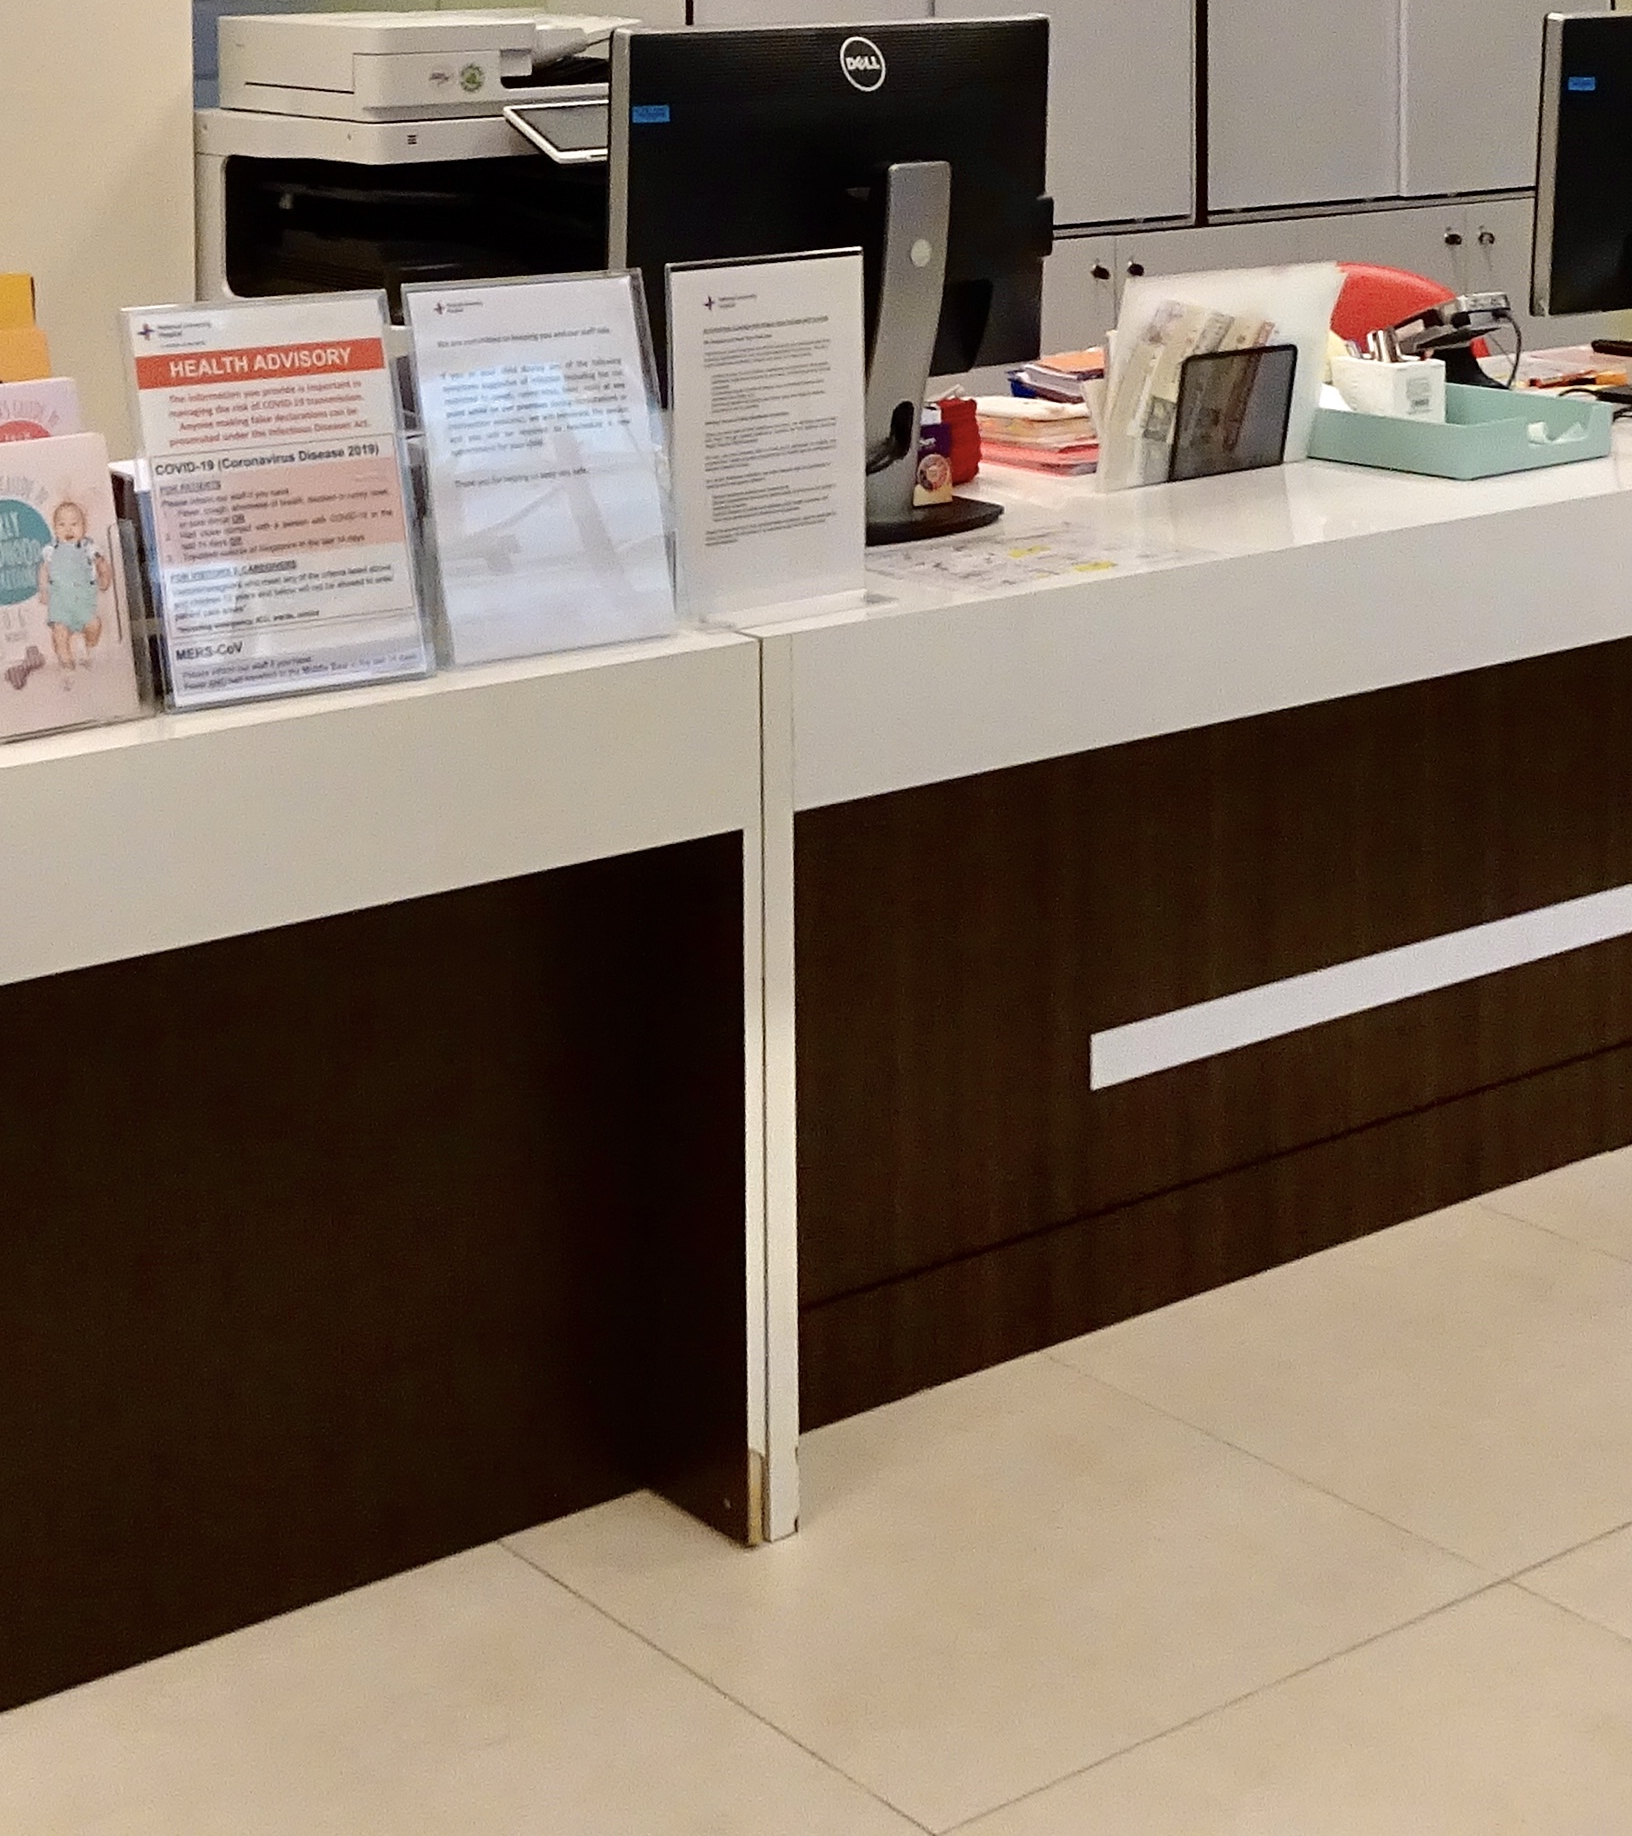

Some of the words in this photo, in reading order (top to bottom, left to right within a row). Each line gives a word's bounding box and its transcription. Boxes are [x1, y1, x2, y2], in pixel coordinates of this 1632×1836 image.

[169, 355, 248, 379] HEALTH
[254, 347, 351, 370] ADVISORY
[262, 386, 296, 398] provide
[307, 380, 351, 393] important
[155, 458, 214, 476] COVID-19
[218, 452, 296, 472] (Coronavirus
[298, 446, 345, 462] Disease
[348, 442, 379, 458] 2019)
[175, 641, 243, 661] MERS-CoV
